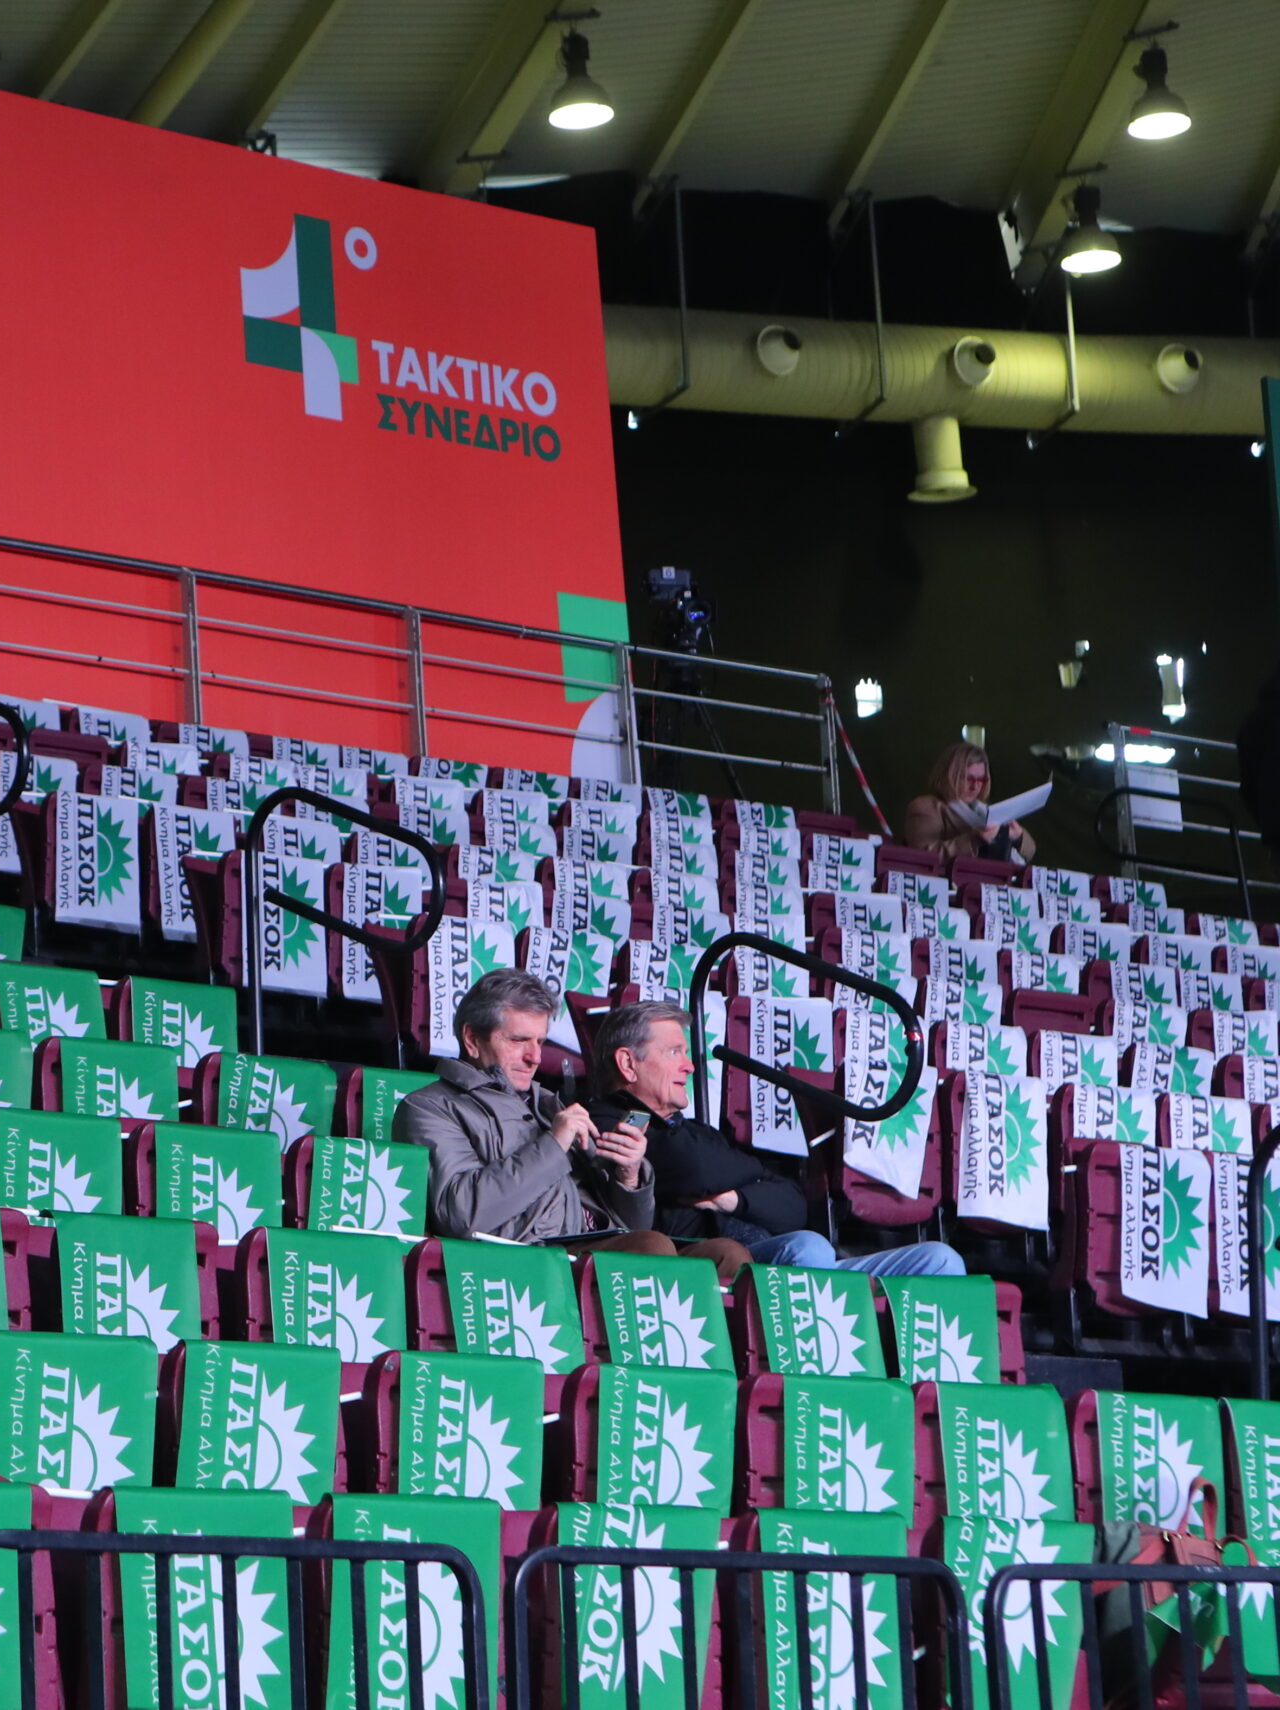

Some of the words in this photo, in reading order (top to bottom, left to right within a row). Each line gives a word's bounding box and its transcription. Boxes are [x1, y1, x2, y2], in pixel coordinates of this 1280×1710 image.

[371, 339, 557, 416] ΤΑΚΤΙΚΟ
[376, 393, 561, 461] ΣΥΝΕΔΡΙΟ
[77, 795, 95, 908] ΠΑΣΟΚ
[228, 1056, 246, 1109] ίνημα
[984, 1073, 1004, 1197] ΠΑΣΟΚ
[1141, 1146, 1160, 1281] ΠΑΣΟΚ
[72, 1242, 88, 1319] Κίνημα
[282, 1251, 298, 1326] Κίνημα
[307, 1262, 332, 1347] ΠΑΣ
[462, 1272, 476, 1344] Κίνημα
[612, 1272, 629, 1344] Κίνημα
[767, 1267, 783, 1336] Κίνημα
[632, 1276, 662, 1368] ΠΑΣ
[789, 1272, 819, 1375] ΠΑΣ
[898, 1290, 910, 1362] Κίνημα
[914, 1303, 937, 1381] ΠΑΣ
[11, 1348, 31, 1435] Κίνημα
[38, 1363, 70, 1489] ΠΑΣ
[200, 1344, 220, 1427] Κίνημα
[411, 1360, 432, 1442] Κίνημα
[610, 1366, 627, 1445] Κίνημα
[434, 1375, 466, 1496] ΠΑΣ
[794, 1391, 810, 1469] Κίνημα
[818, 1405, 842, 1511] ΠΑΣ
[953, 1407, 970, 1498] Κίνημα
[976, 1417, 1005, 1516] ΠΑΣ
[1110, 1394, 1128, 1467] Κίνημα
[1133, 1406, 1156, 1525] ΠΑΣΟ
[1245, 1425, 1258, 1499] Κίνημα
